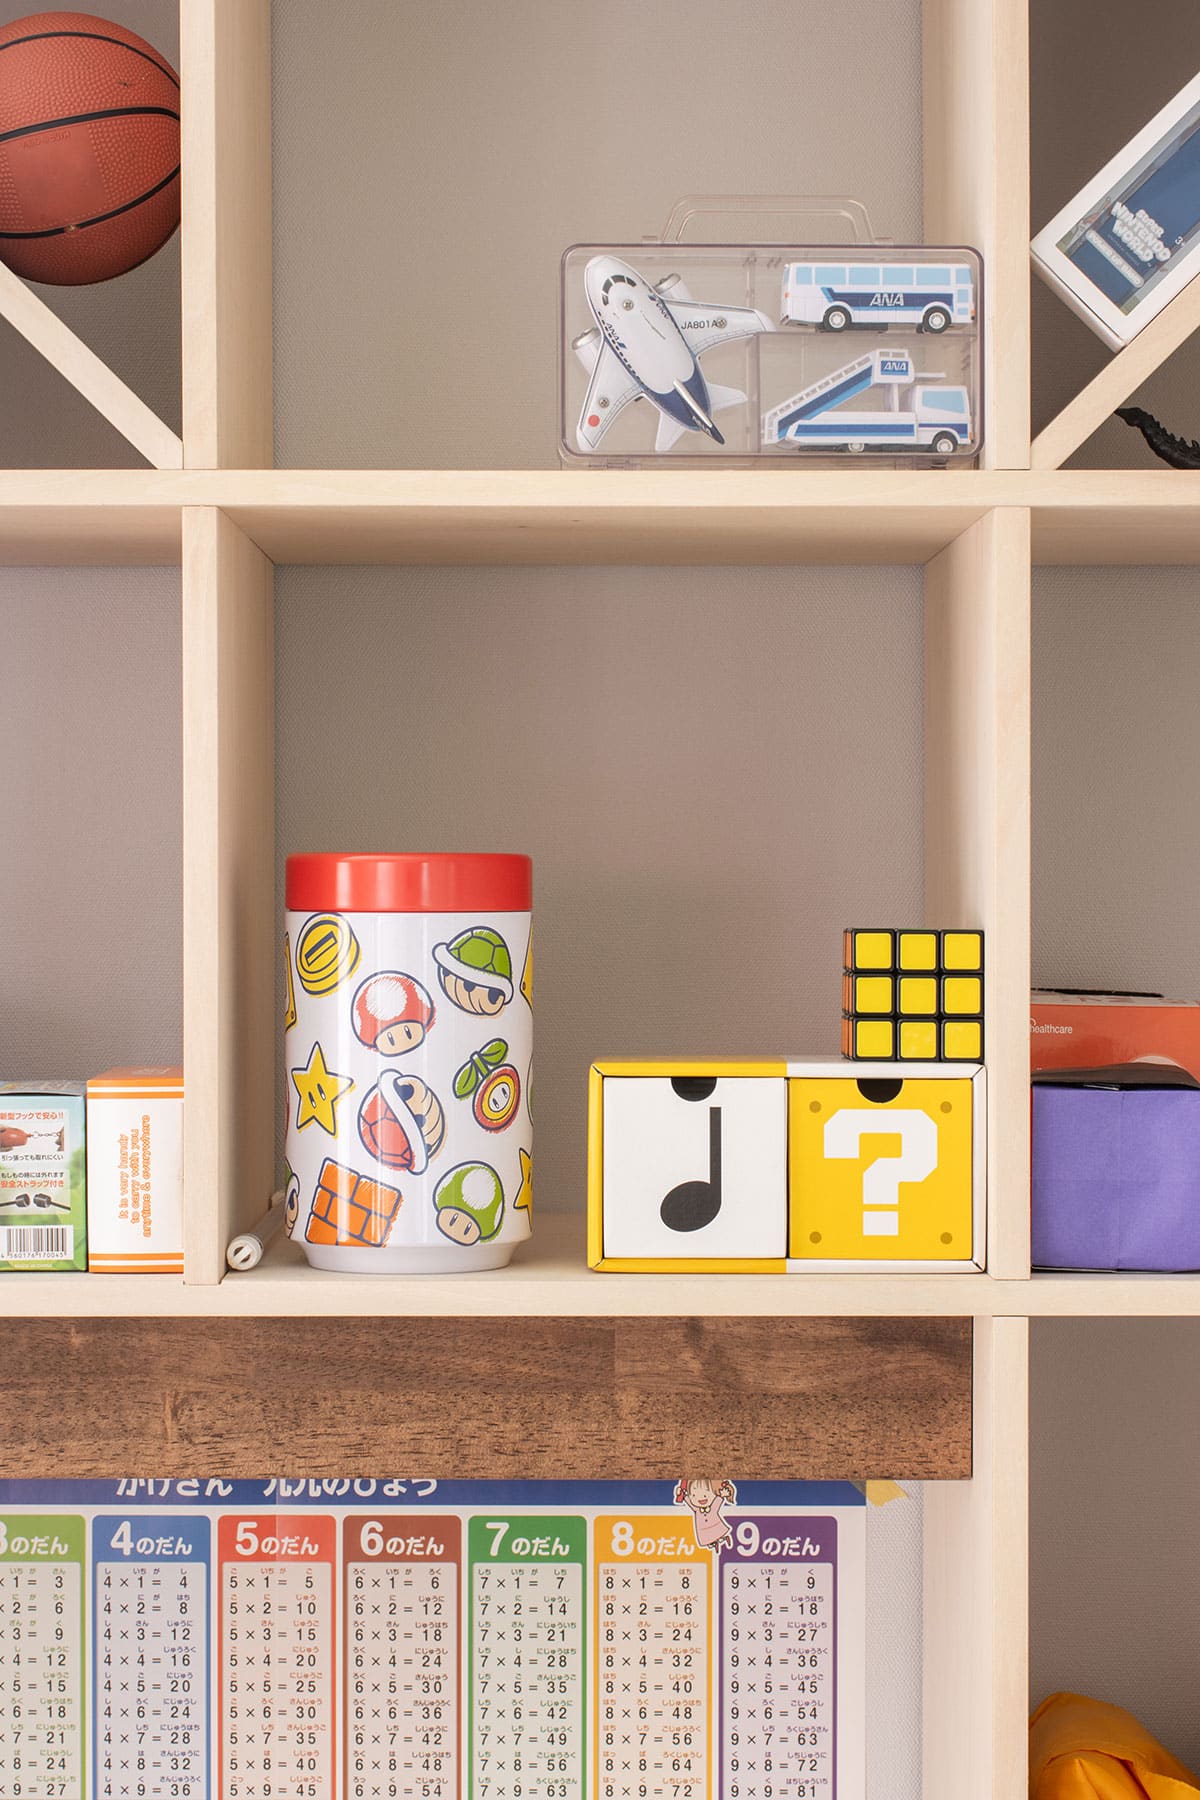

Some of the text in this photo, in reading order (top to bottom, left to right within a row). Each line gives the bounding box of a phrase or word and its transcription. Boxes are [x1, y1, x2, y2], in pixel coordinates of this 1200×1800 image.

[1111, 202, 1171, 261] NINTENDO
[1113, 220, 1153, 262] WORLD
[870, 293, 904, 306] ANA
[681, 320, 718, 330] JA801A
[883, 361, 906, 371] ANA
[131, 1128, 141, 1150] you
[140, 1115, 151, 1180] everywhere
[129, 1152, 140, 1177] with
[131, 1179, 141, 1209] carry
[141, 1194, 152, 1238] anytime
[110, 1521, 193, 1556] 4のだん
[235, 1521, 319, 1556] 5のだん
[359, 1521, 445, 1556] 6のだん
[485, 1522, 570, 1557] 7のだん
[611, 1522, 695, 1557] 8のだん
[736, 1522, 821, 1557] 9のだん
